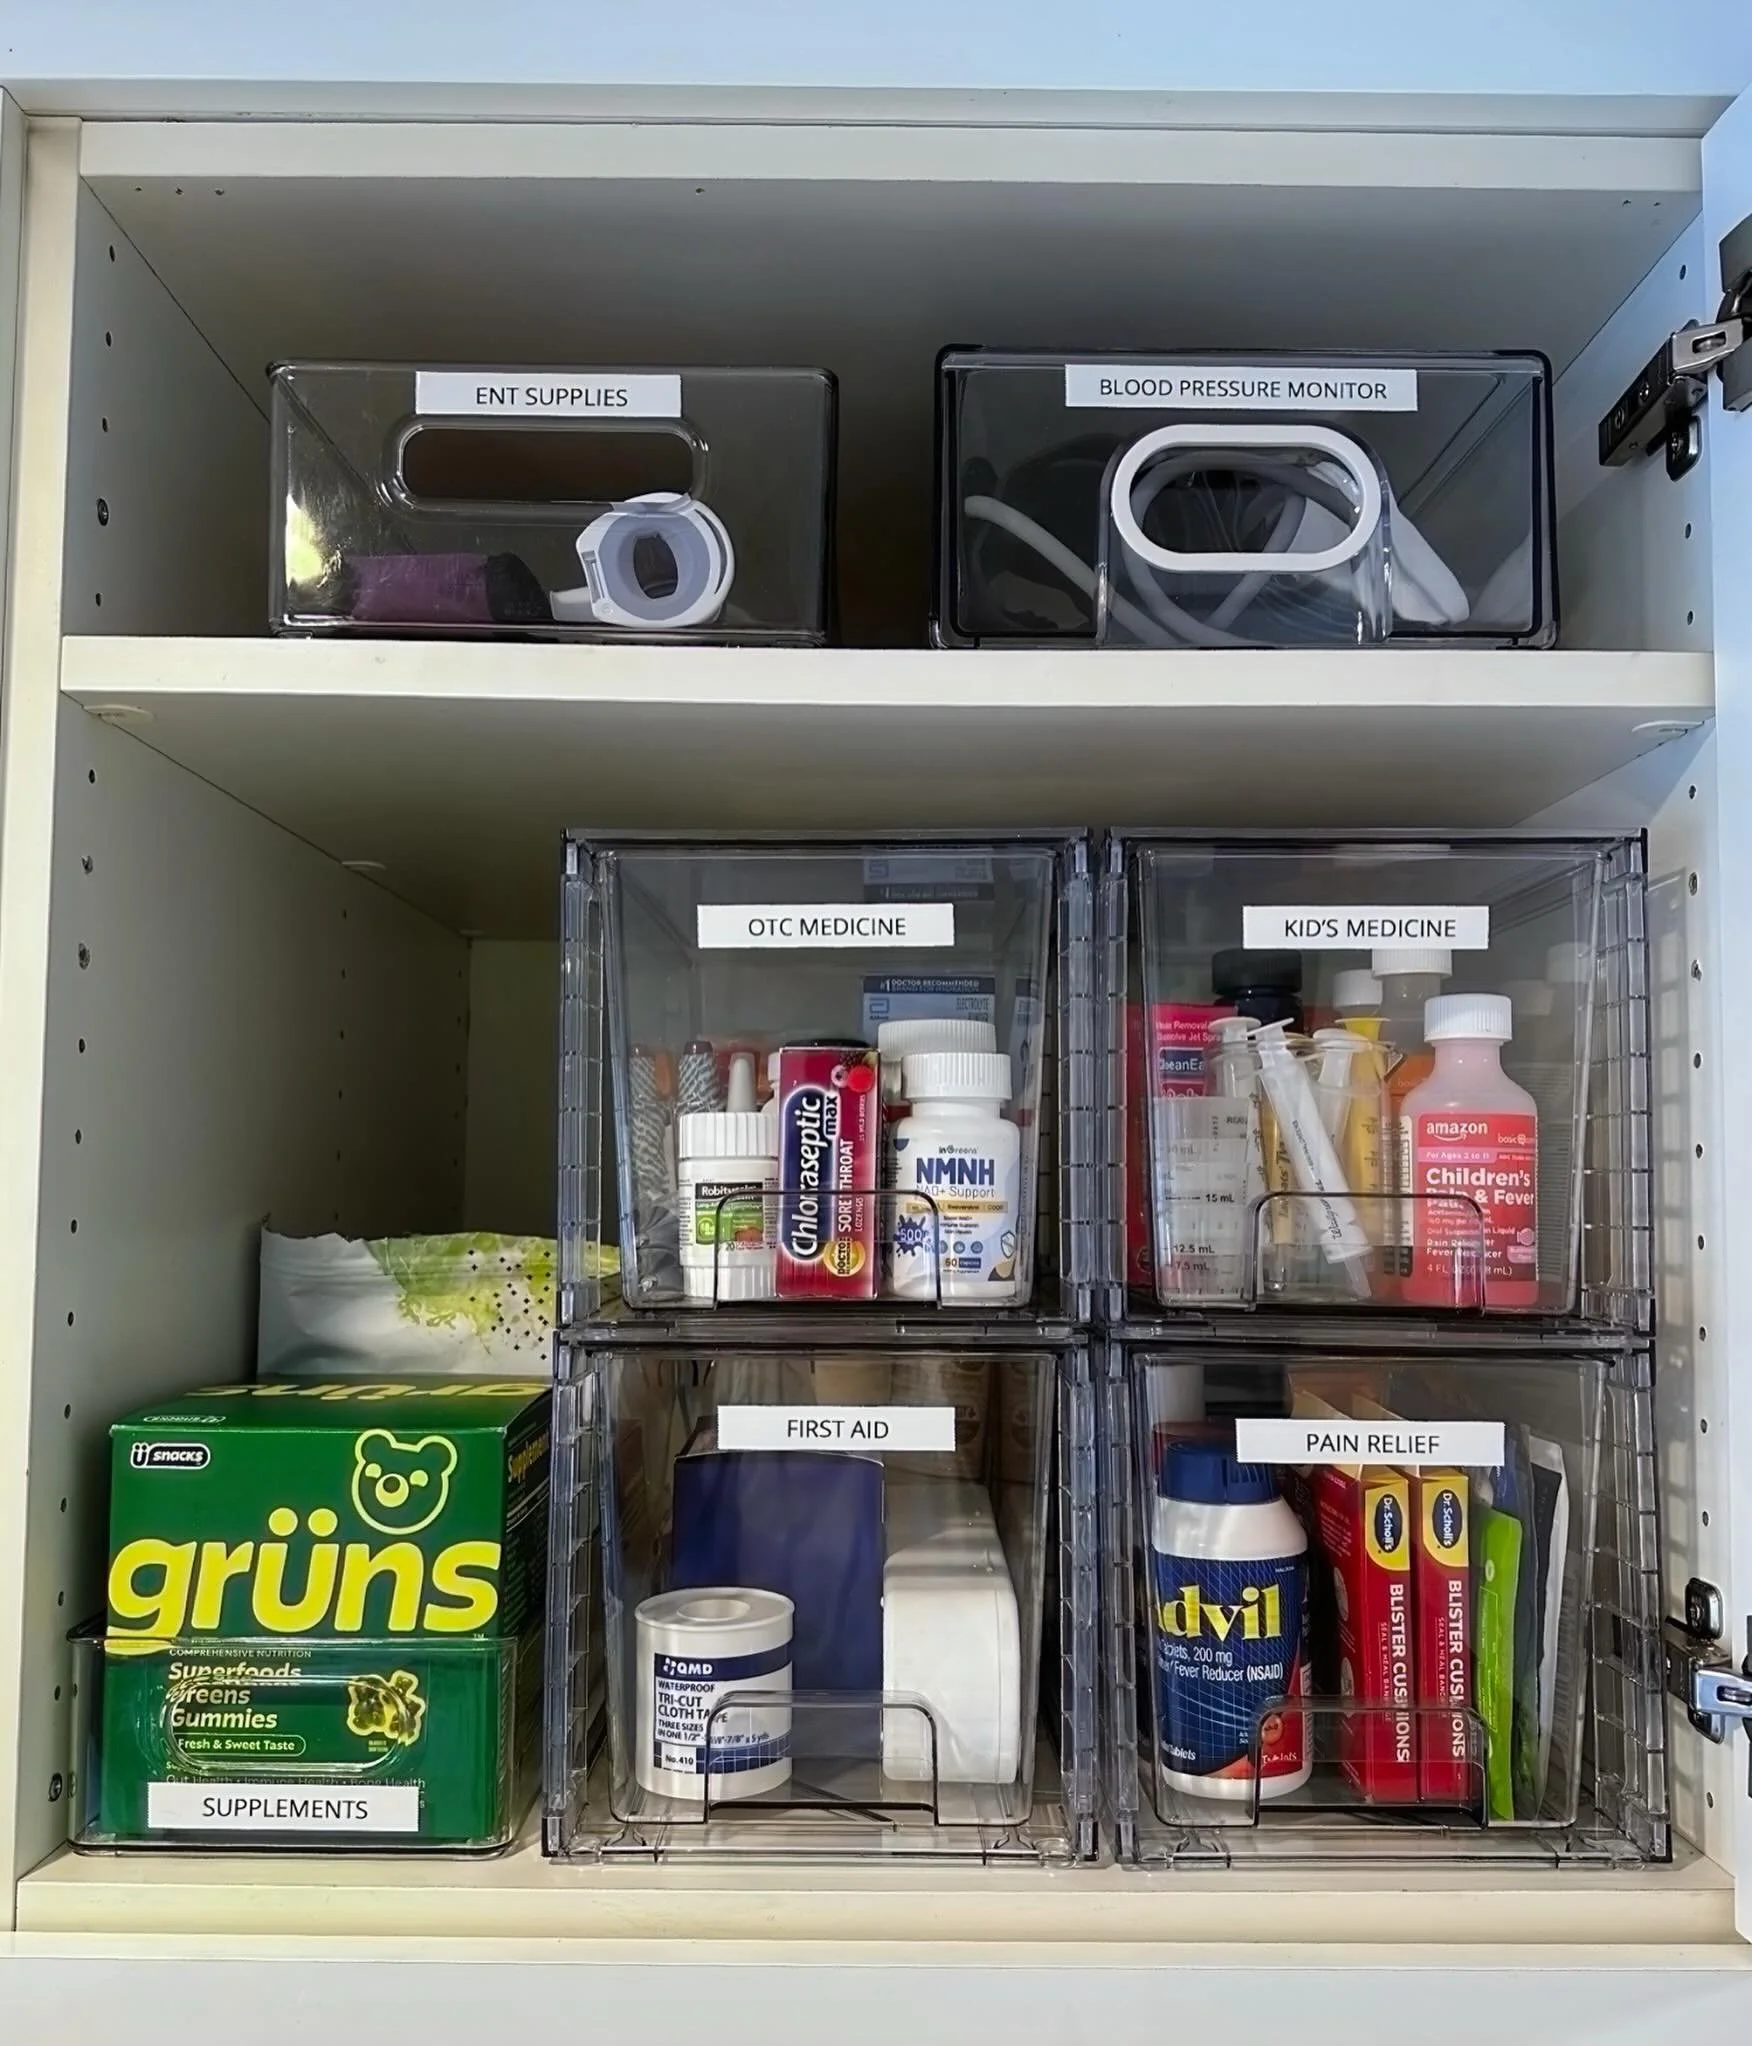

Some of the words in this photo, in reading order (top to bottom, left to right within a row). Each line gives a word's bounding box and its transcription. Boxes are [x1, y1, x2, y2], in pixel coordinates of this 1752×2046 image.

[475, 387, 519, 405] ENT
[525, 387, 628, 407] SUPPLIES
[1099, 379, 1173, 396] BLOOD
[1179, 380, 1281, 398] PRESSURE
[1287, 382, 1388, 399] MONITOR
[748, 918, 793, 936] OTC
[800, 917, 906, 936] MEDICINE
[1284, 919, 1339, 938] KID'S
[1347, 919, 1457, 938] MEDICINE
[824, 1095, 838, 1136] max
[1426, 1122, 1488, 1135] amazon
[838, 1138, 854, 1193] THROAT
[916, 1157, 995, 1186] NMNH
[792, 1095, 828, 1258] Chloraseptic
[1426, 1168, 1531, 1187] Children's
[948, 1185, 995, 1199] Support
[1205, 1193, 1219, 1203] 15
[1220, 1193, 1235, 1203] mL
[1475, 1189, 1488, 1204] &
[1494, 1189, 1534, 1206] Fever
[837, 1194, 853, 1233] SORE
[1173, 1243, 1196, 1253] 12.5
[1198, 1243, 1215, 1253] mL
[1193, 1260, 1209, 1271] mL
[787, 1420, 844, 1438] FIRST
[850, 1420, 889, 1439] AID
[1306, 1433, 1359, 1453] PAIN
[1367, 1434, 1440, 1454] RELIEF
[152, 1450, 203, 1463] snacks
[103, 1507, 501, 1656] grüns
[1156, 1583, 1282, 1642] dvil
[1390, 1584, 1406, 1658] BLISTER
[1449, 1580, 1463, 1654] BLISTER
[169, 1649, 255, 1658] COMPREHENSIVE
[257, 1650, 312, 1659] NUTRITION
[1193, 1647, 1213, 1663] 200
[1215, 1651, 1233, 1668] mg
[168, 1661, 301, 1684] Superfoods
[677, 1662, 713, 1675] QMD
[1202, 1664, 1244, 1681] Reducer
[1246, 1662, 1284, 1682] (NSAID)
[658, 1680, 715, 1693] WATERPROOF
[658, 1692, 702, 1707] TRI-CUT
[171, 1708, 278, 1730] Gummies
[658, 1705, 695, 1719] CLOTH
[658, 1719, 681, 1730] THREE
[681, 1723, 703, 1732] SIZES
[668, 1730, 682, 1739] ONE
[179, 1739, 210, 1751] Fresh
[213, 1739, 222, 1750] &
[225, 1740, 260, 1750] Sweet
[264, 1740, 295, 1751] Taste
[202, 1798, 368, 1819] SUPPLEMENTS
